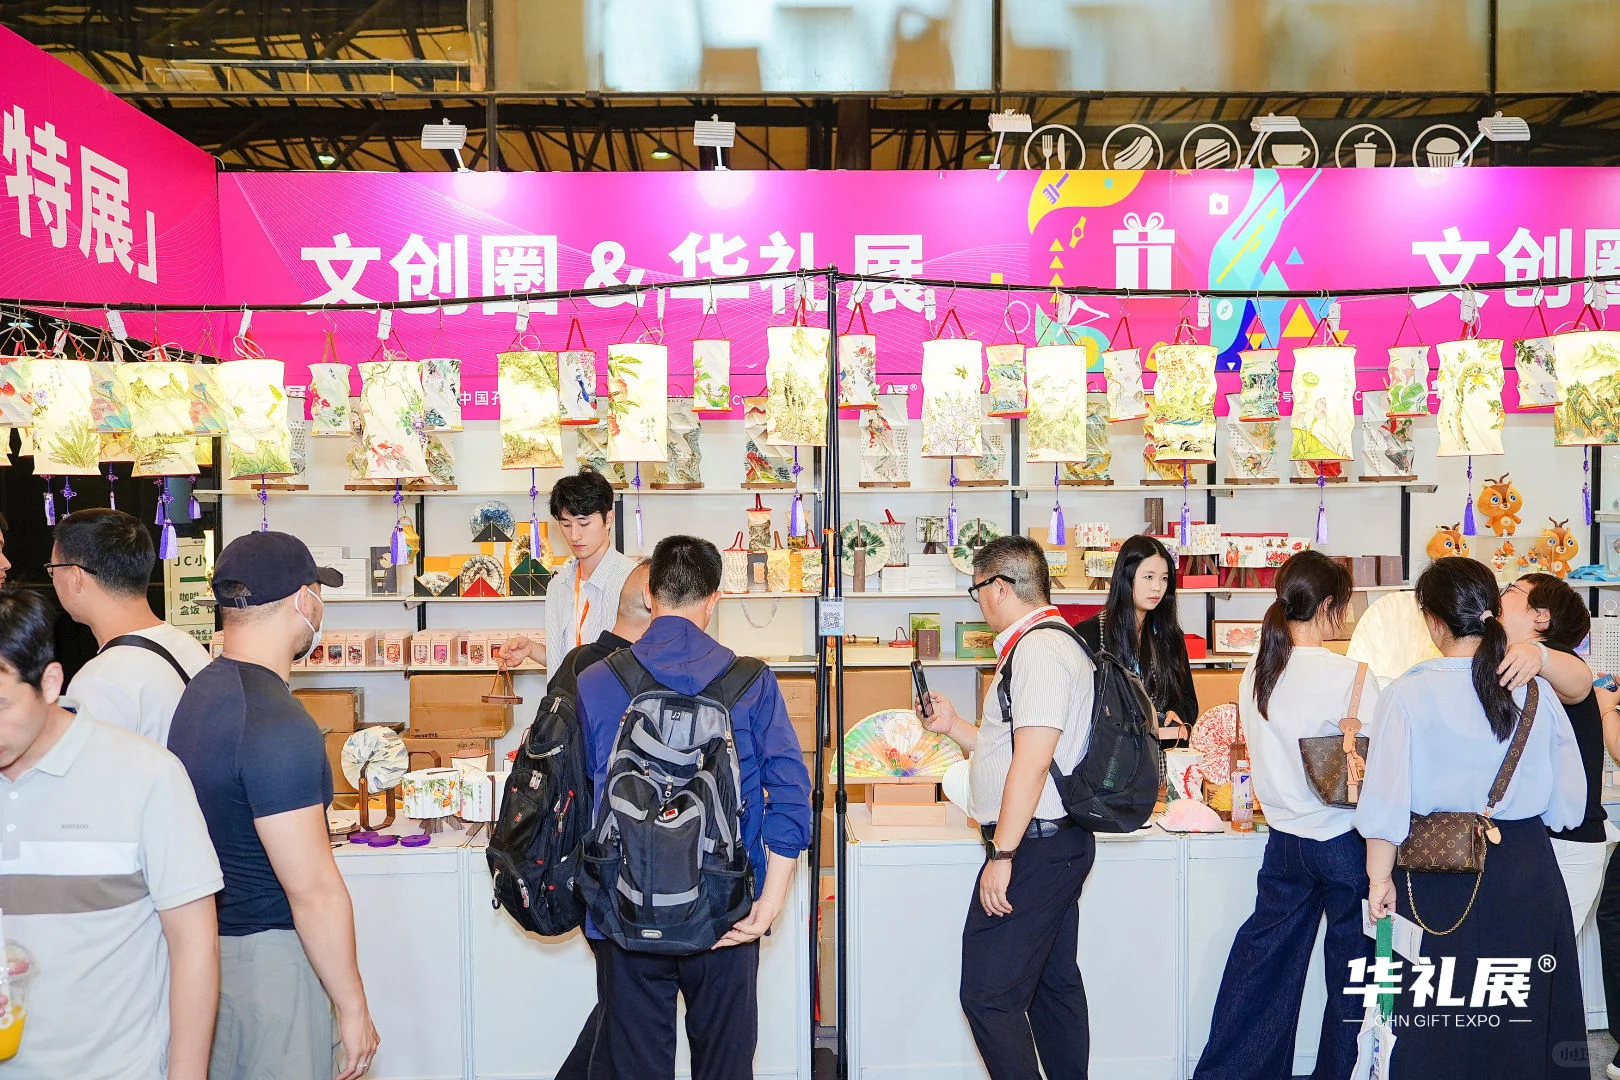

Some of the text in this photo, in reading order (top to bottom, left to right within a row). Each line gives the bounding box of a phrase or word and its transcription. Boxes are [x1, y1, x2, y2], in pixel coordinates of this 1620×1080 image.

[299, 231, 924, 316] 文创圈 & 华礼展
